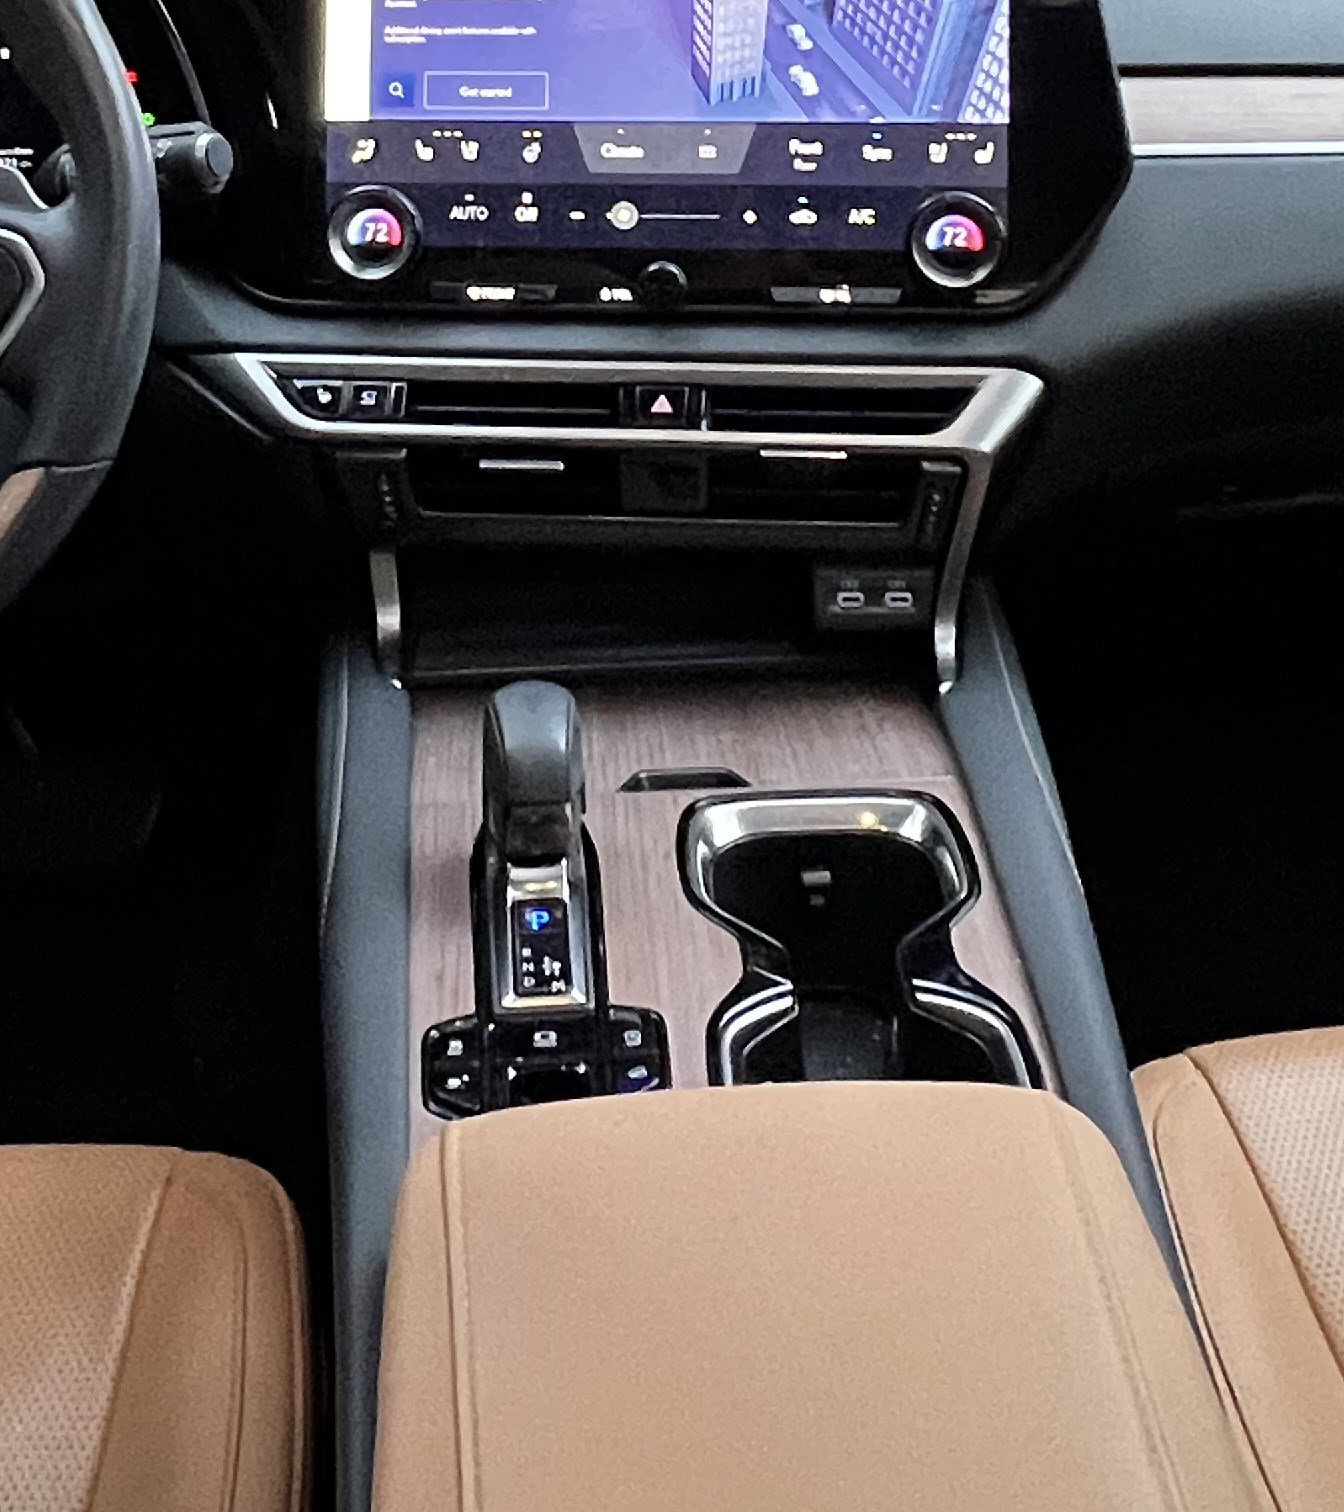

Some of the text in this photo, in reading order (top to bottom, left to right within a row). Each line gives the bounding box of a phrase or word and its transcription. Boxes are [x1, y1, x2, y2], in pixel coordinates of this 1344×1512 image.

[449, 205, 490, 221] AUTO
[363, 222, 391, 244] 72
[942, 226, 968, 248] 72
[531, 909, 550, 931] P
